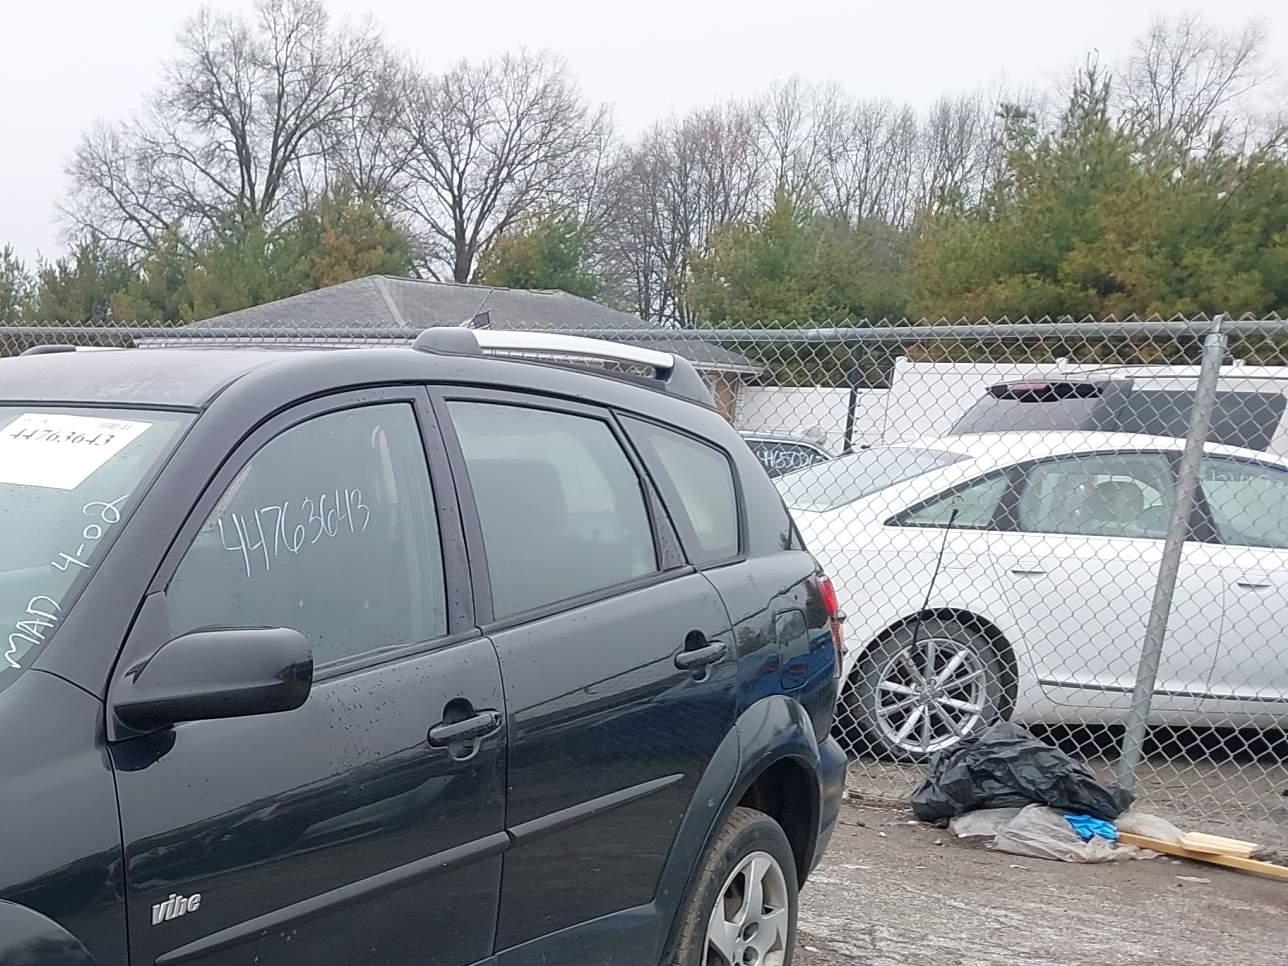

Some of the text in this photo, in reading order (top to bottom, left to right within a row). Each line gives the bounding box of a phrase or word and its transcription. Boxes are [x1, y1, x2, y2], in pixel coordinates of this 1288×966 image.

[10, 428, 115, 447] 44763643
[218, 488, 370, 578] 44763643
[4, 494, 129, 669] MAD 4-02
[152, 893, 201, 926] Vibe
